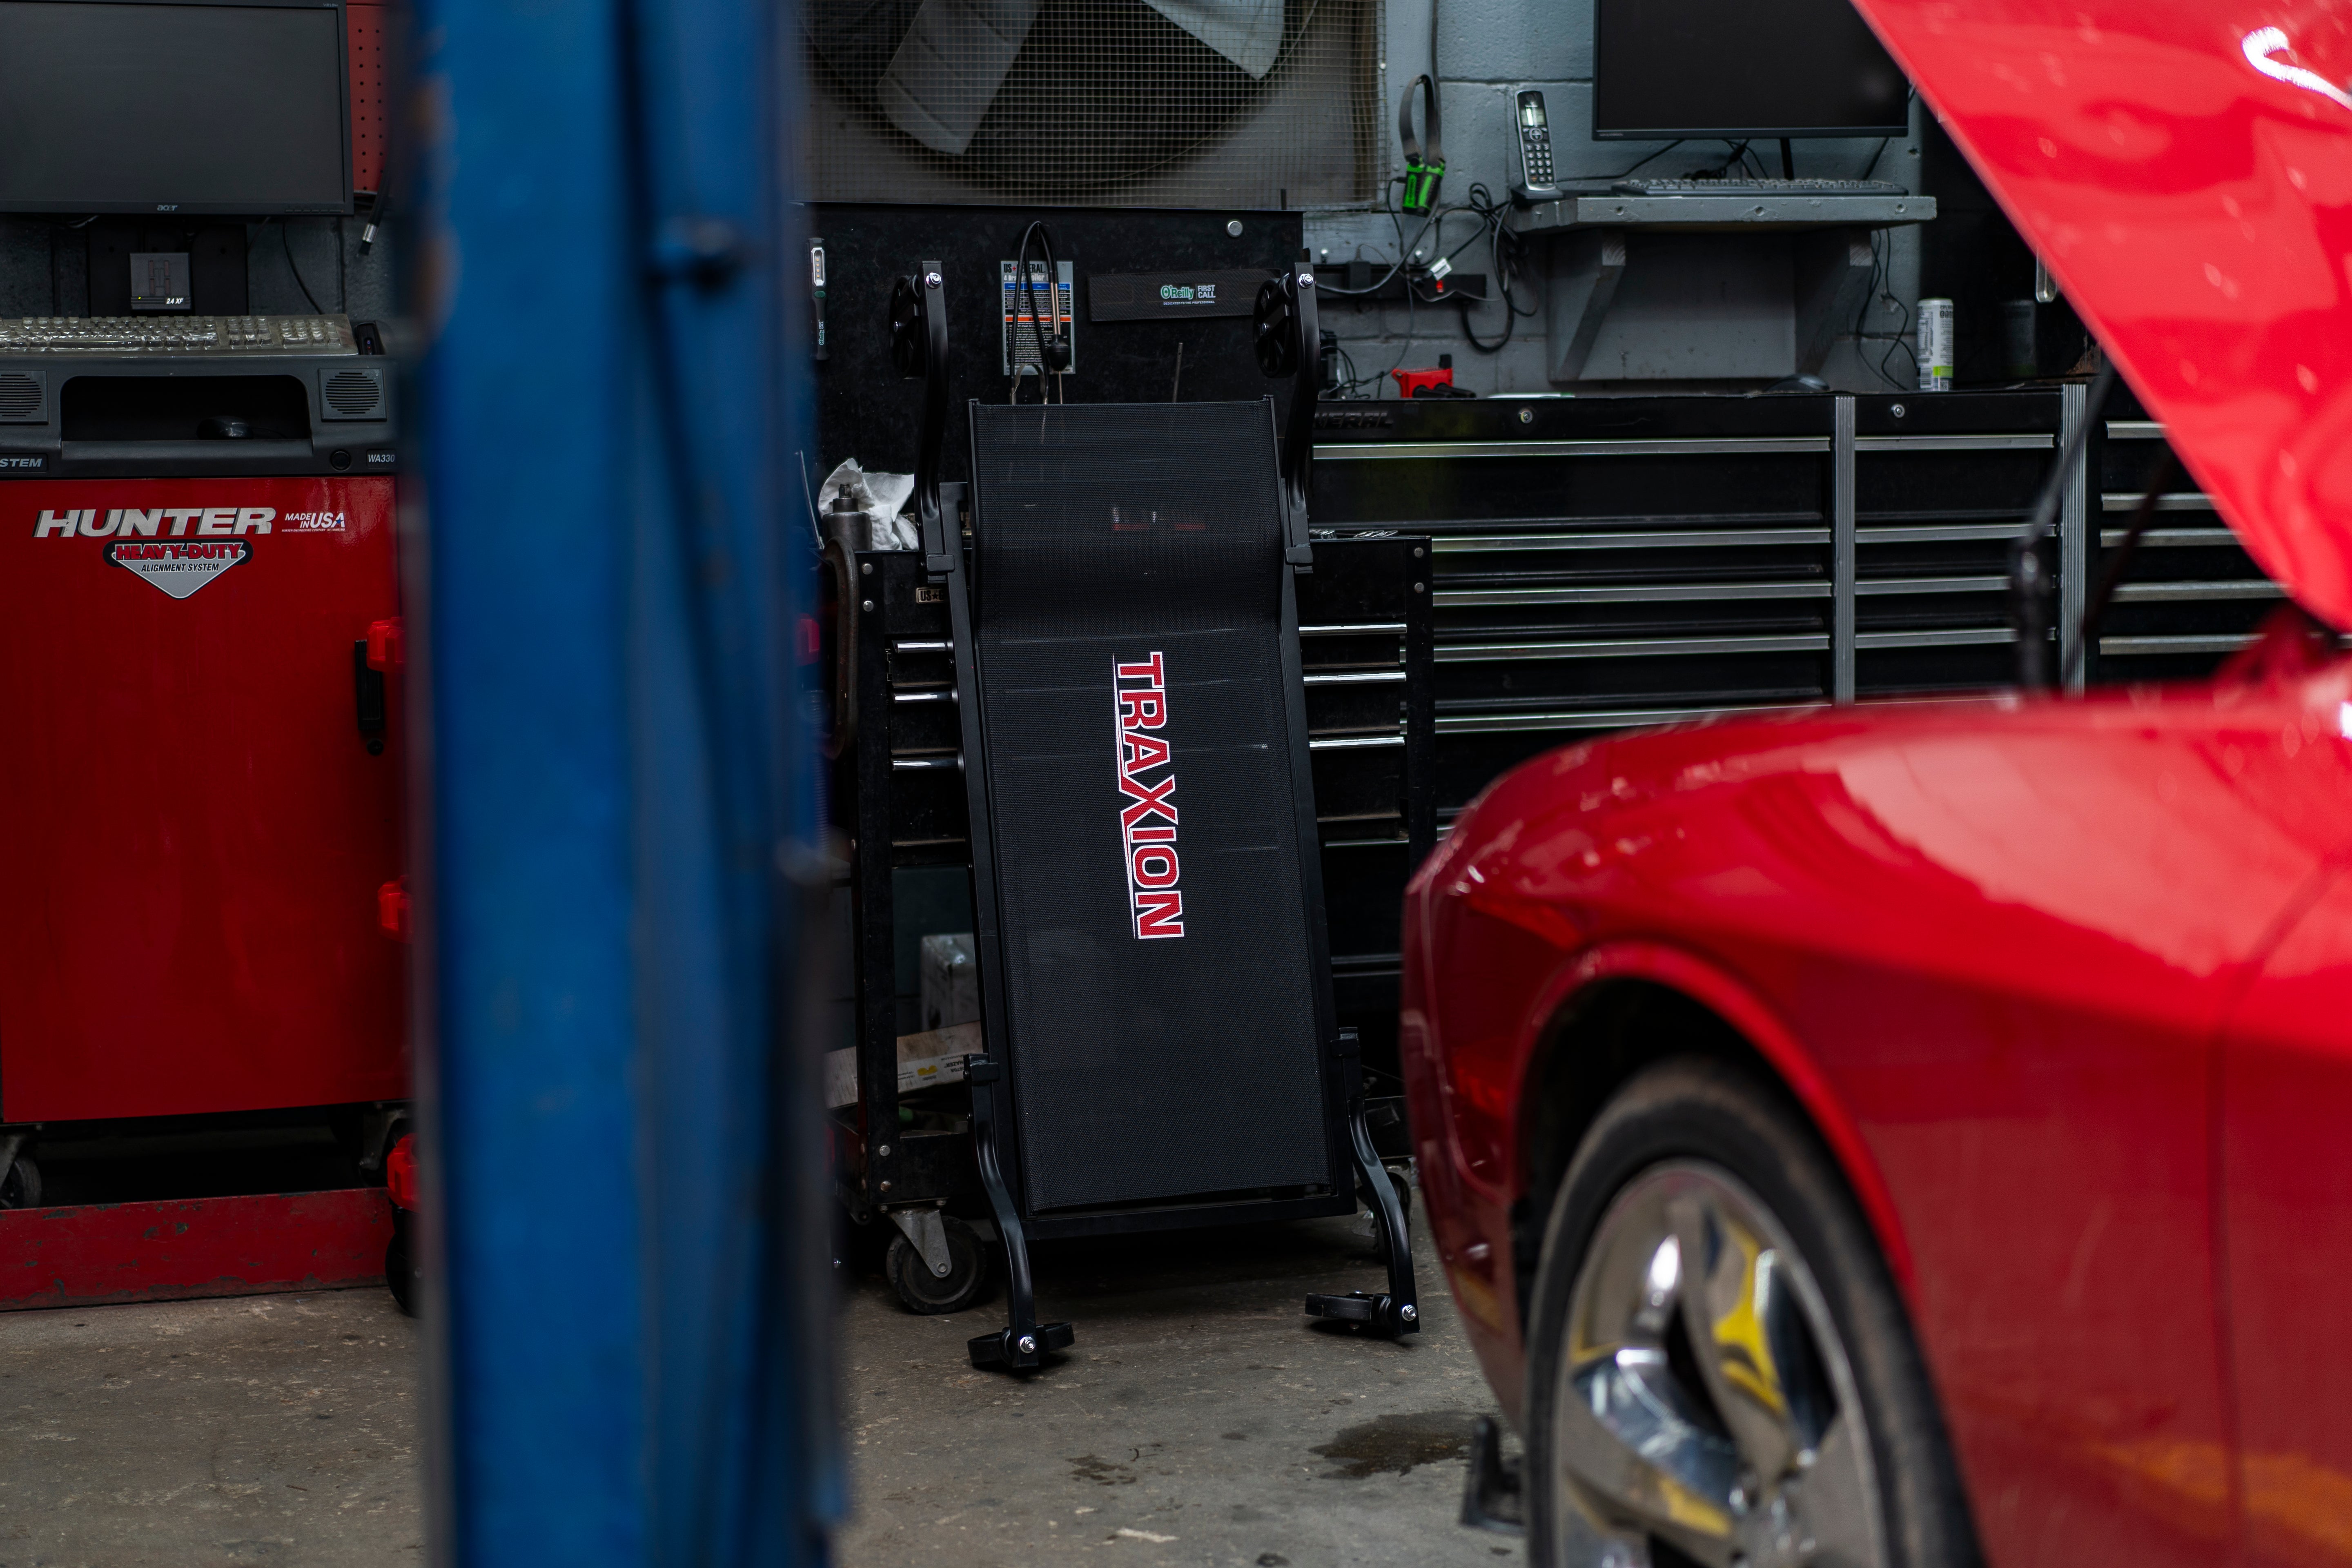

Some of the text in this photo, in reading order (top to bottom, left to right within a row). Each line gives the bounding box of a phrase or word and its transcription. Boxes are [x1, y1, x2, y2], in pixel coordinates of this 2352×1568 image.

[1004, 264, 1012, 273] US
[1161, 285, 1195, 300] O'Reilly
[368, 454, 395, 463] WA330
[33, 508, 276, 537] HUNTER
[310, 512, 345, 528] USA
[115, 543, 243, 560] HEAVY-DUTY
[141, 564, 186, 572] ALIGNMENT
[920, 590, 931, 601] US
[1118, 652, 1184, 939] TRAXION
